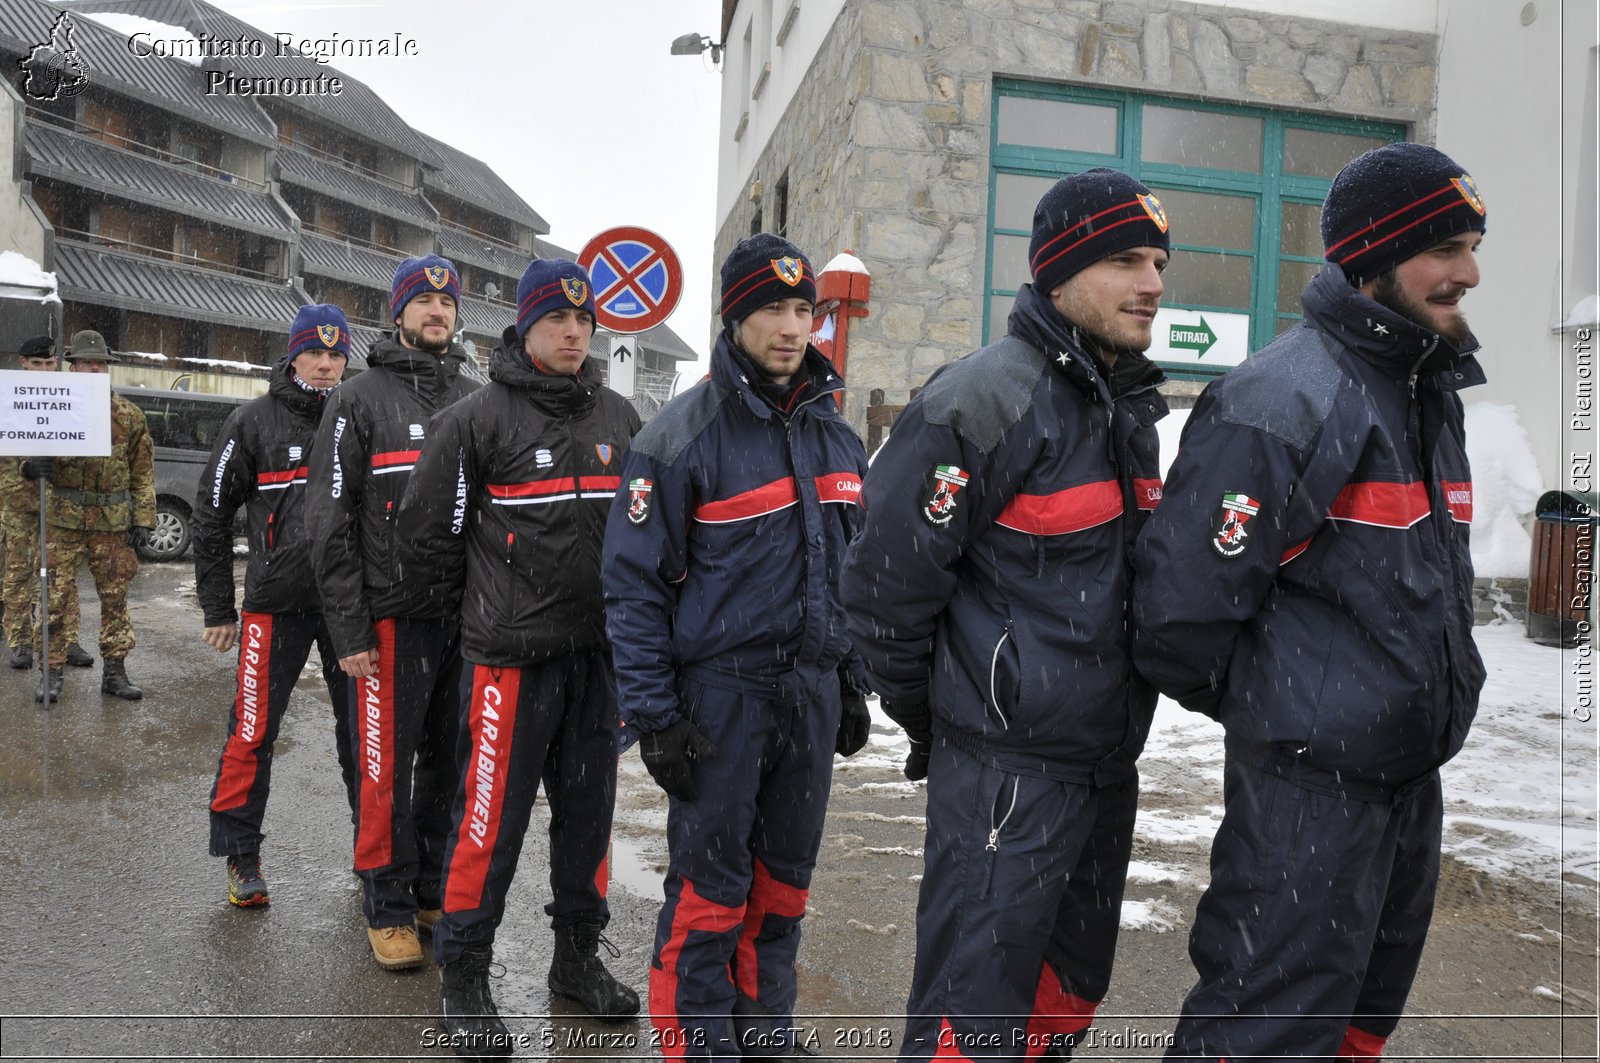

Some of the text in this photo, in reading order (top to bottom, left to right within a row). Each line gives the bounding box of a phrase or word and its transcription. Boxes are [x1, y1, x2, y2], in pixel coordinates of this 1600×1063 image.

[1170, 330, 1210, 344] ENTRATA
[14, 386, 71, 397] ISTITUTI
[13, 401, 72, 411] MILITARI
[36, 416, 50, 425] DI
[0, 430, 86, 441] FORMAZIONE
[212, 438, 236, 508] CARABINIERI
[241, 623, 262, 743] CARABINIERI
[365, 667, 382, 783] RABINIERI
[469, 685, 502, 848] CARABINIERI
